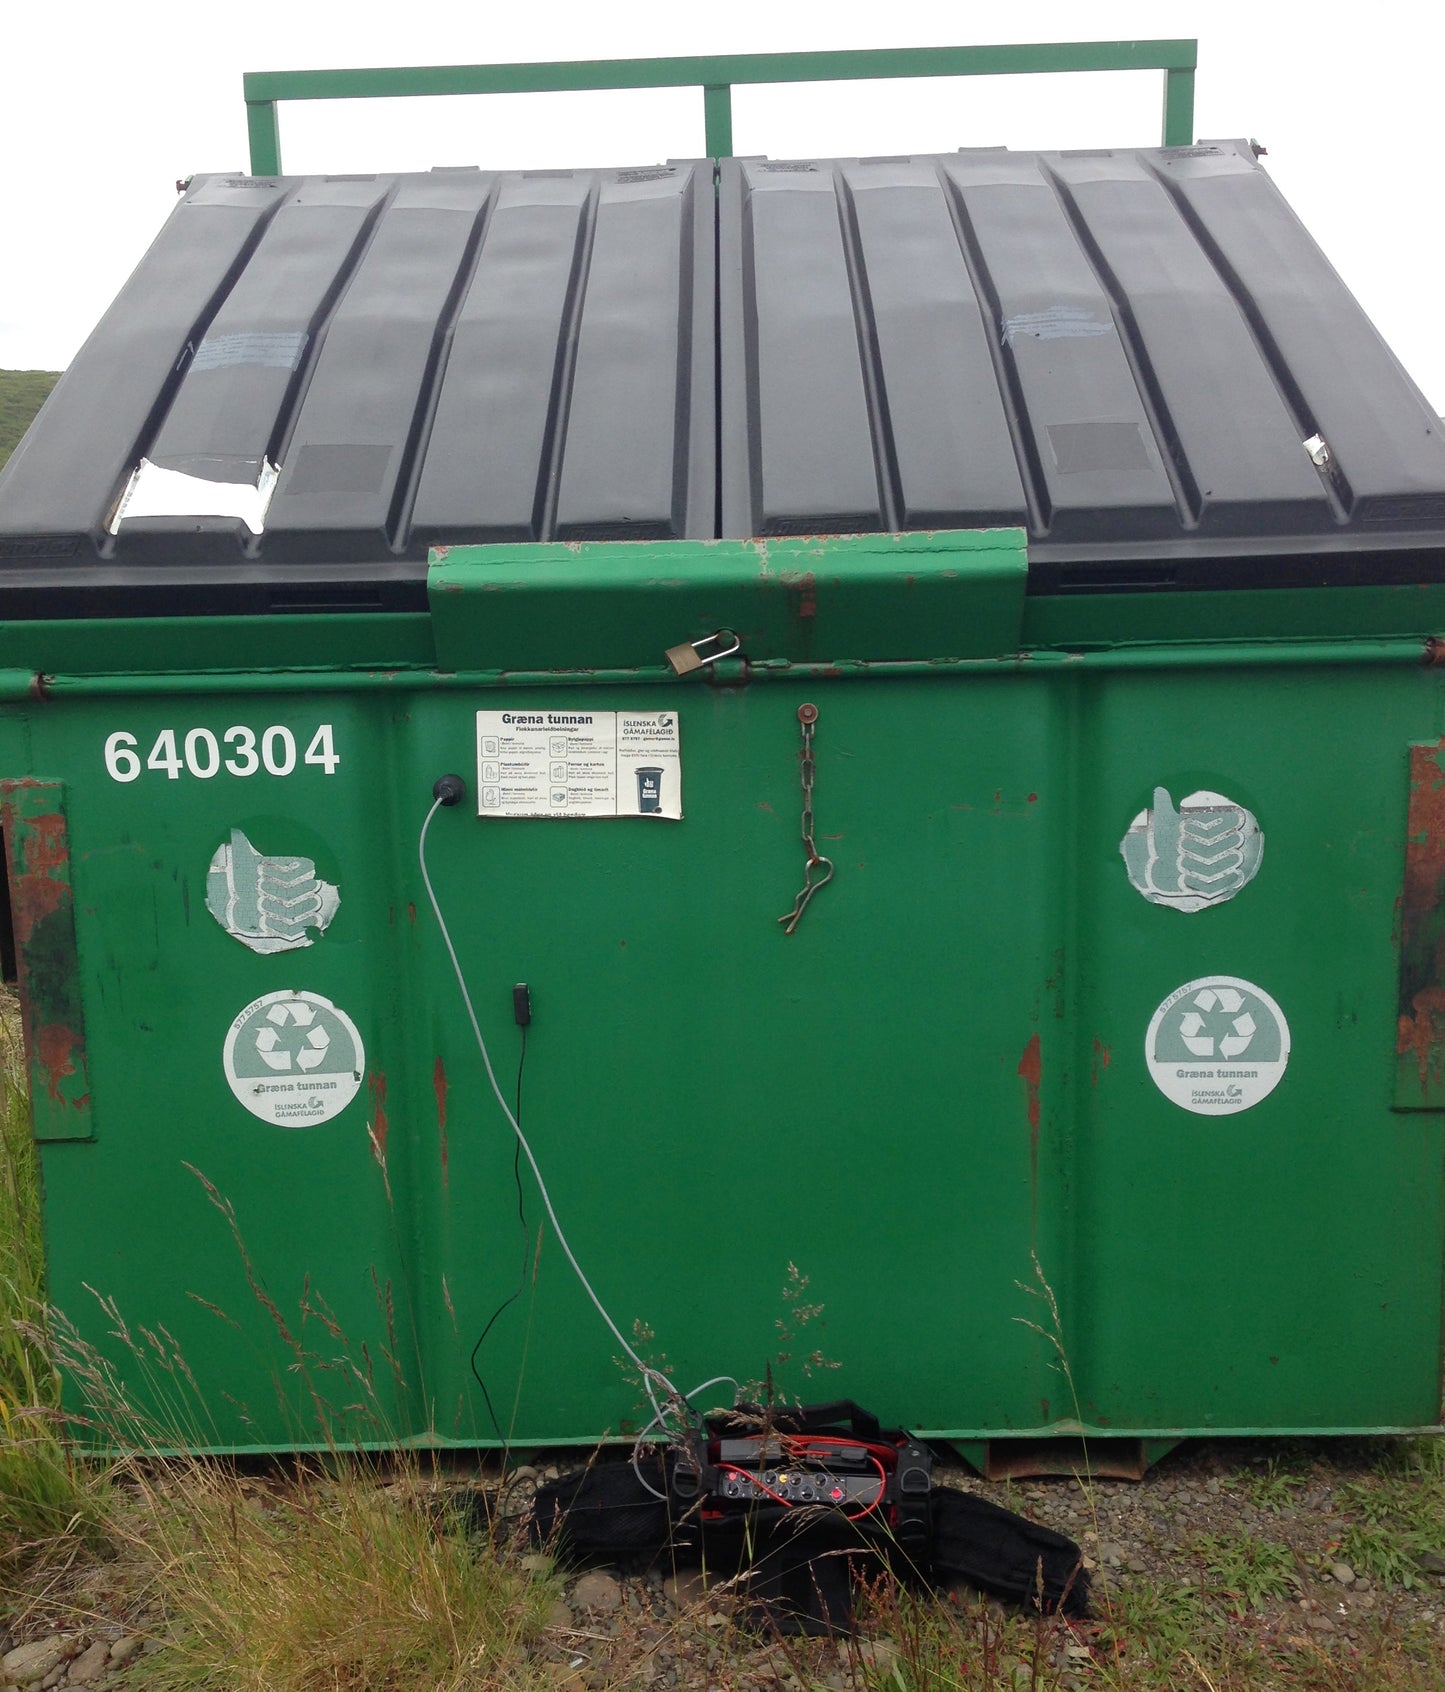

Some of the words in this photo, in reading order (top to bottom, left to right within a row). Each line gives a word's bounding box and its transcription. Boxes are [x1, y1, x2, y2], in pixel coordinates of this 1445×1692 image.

[502, 714, 544, 725] Græna
[548, 713, 593, 725] tunnan
[623, 719, 657, 727] ÍSLENSKA
[104, 724, 341, 783] 640304
[1176, 1069, 1214, 1079] Græna
[1217, 1069, 1258, 1079] tunnan
[257, 1083, 294, 1093] Græna
[297, 1081, 337, 1091] tunnan
